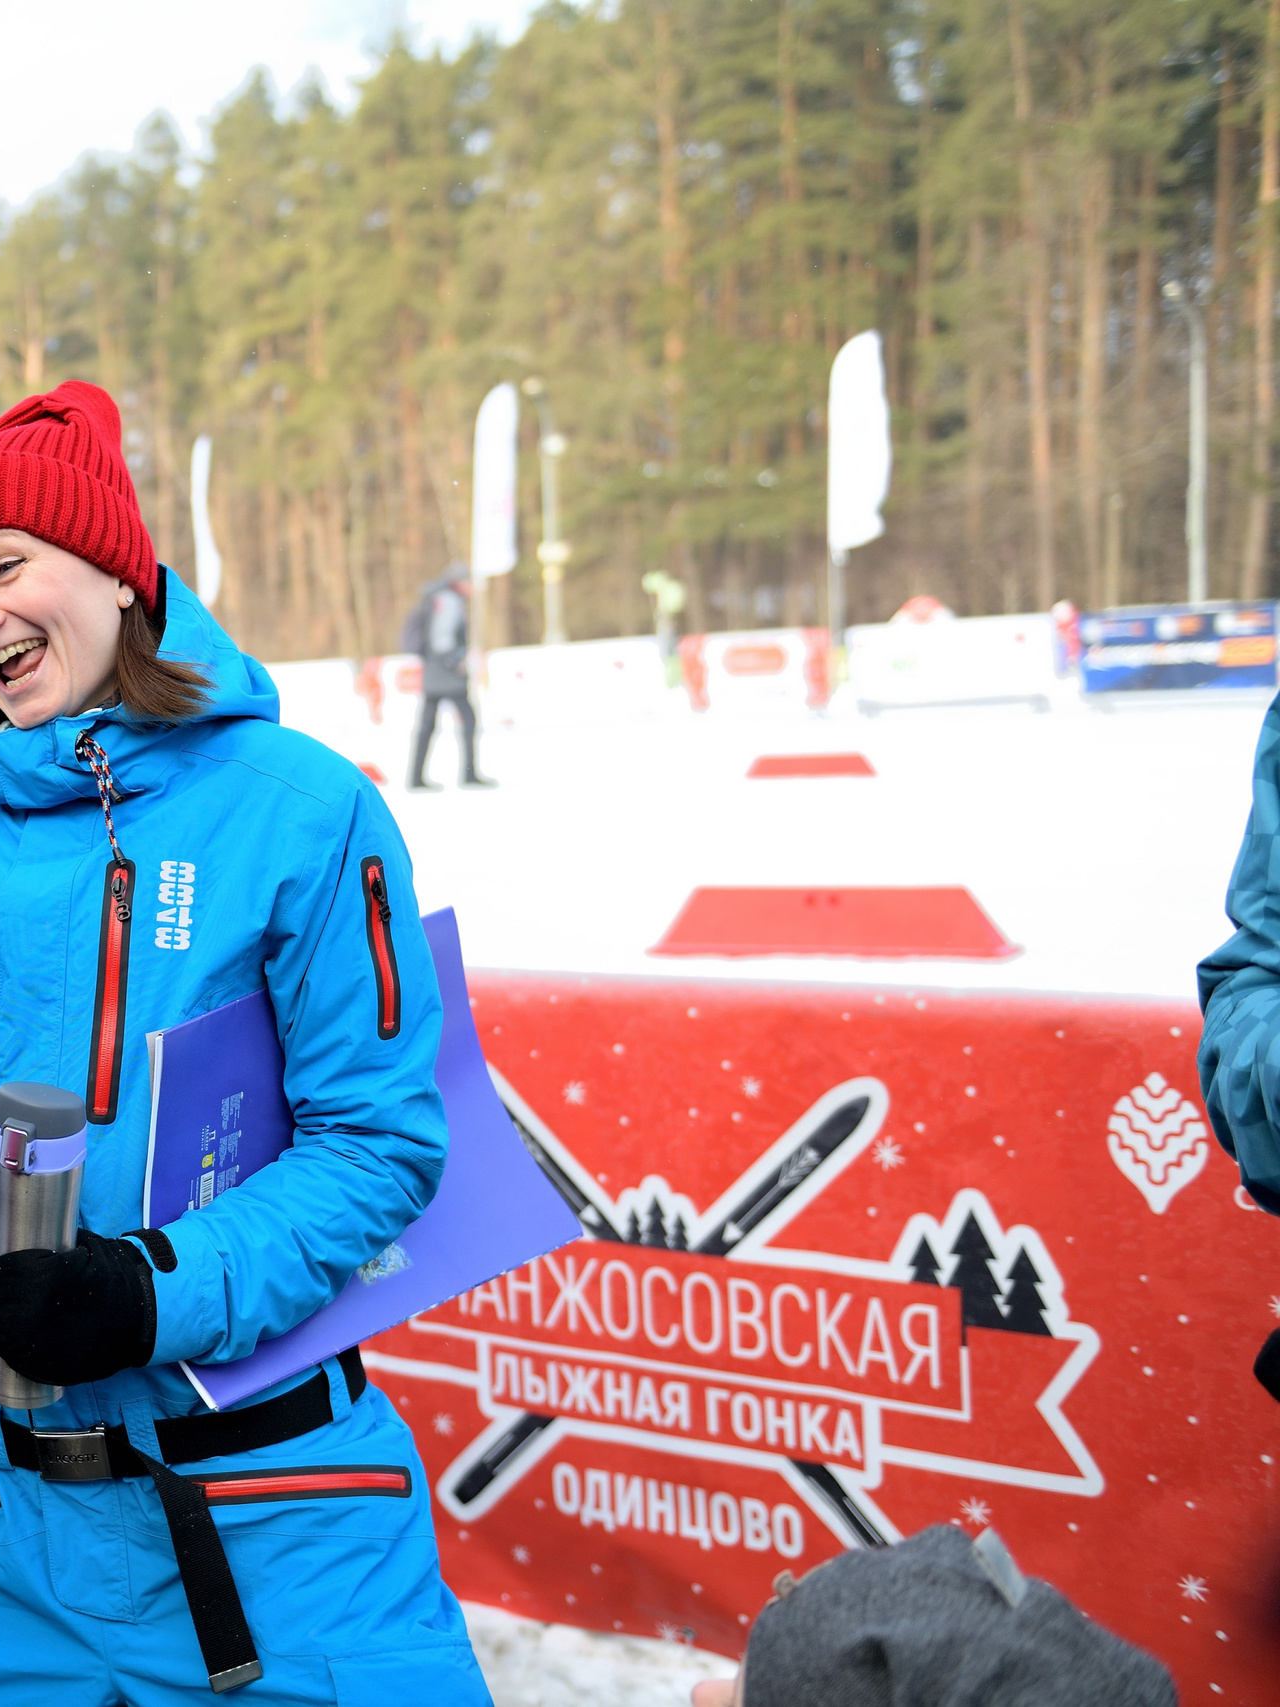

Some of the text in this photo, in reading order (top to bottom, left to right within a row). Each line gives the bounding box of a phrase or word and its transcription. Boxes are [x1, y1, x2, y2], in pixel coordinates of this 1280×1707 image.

[458, 1254, 942, 1390] АНЖОСОВСКАЯ
[47, 1453, 99, 1464] LACOSTE
[492, 1352, 863, 1462] ЛЫЖНАЯ ГОНКА
[551, 1462, 805, 1559] ОДИНЦОВО
